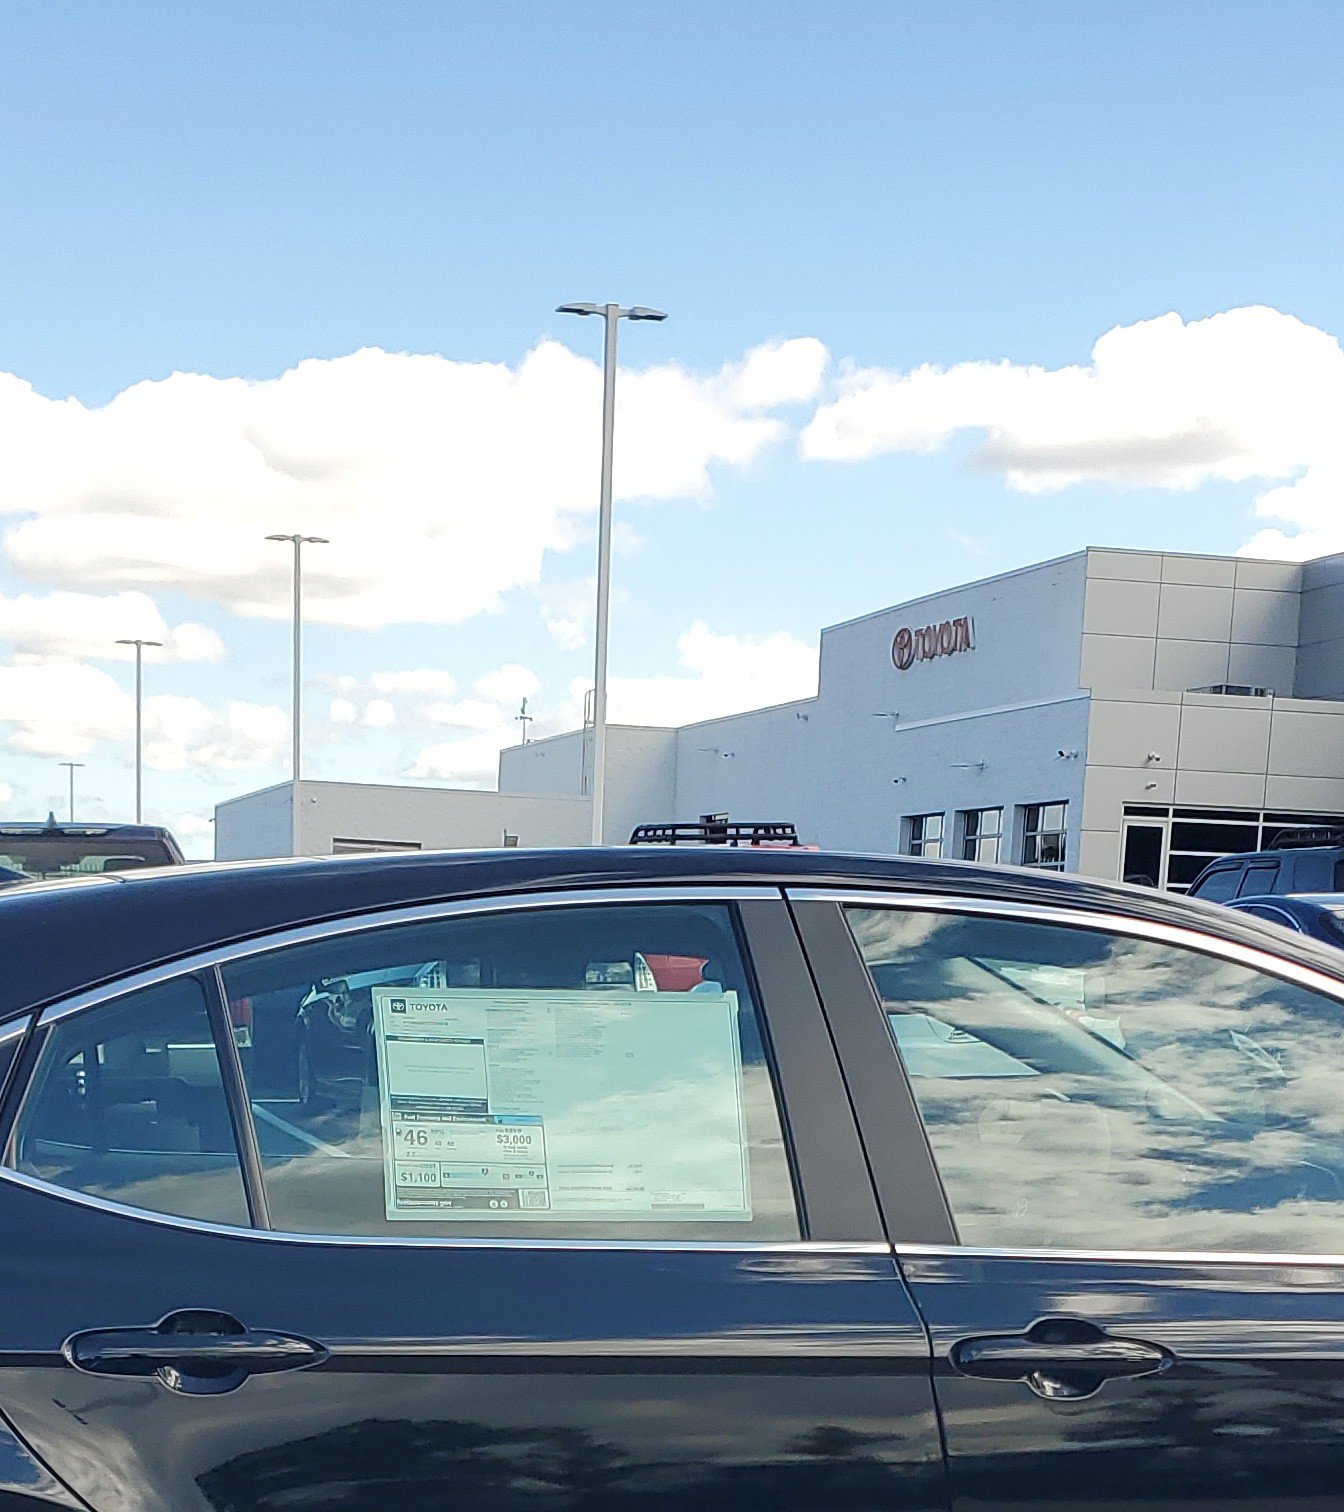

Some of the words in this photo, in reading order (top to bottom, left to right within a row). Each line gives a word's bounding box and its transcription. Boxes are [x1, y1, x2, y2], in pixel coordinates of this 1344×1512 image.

[913, 616, 971, 662] TOYOTA
[410, 1003, 448, 1012] TOYOTA
[404, 1129, 428, 1146] 46
[496, 1134, 532, 1146] $3,000
[400, 1172, 437, 1183] $1,100
